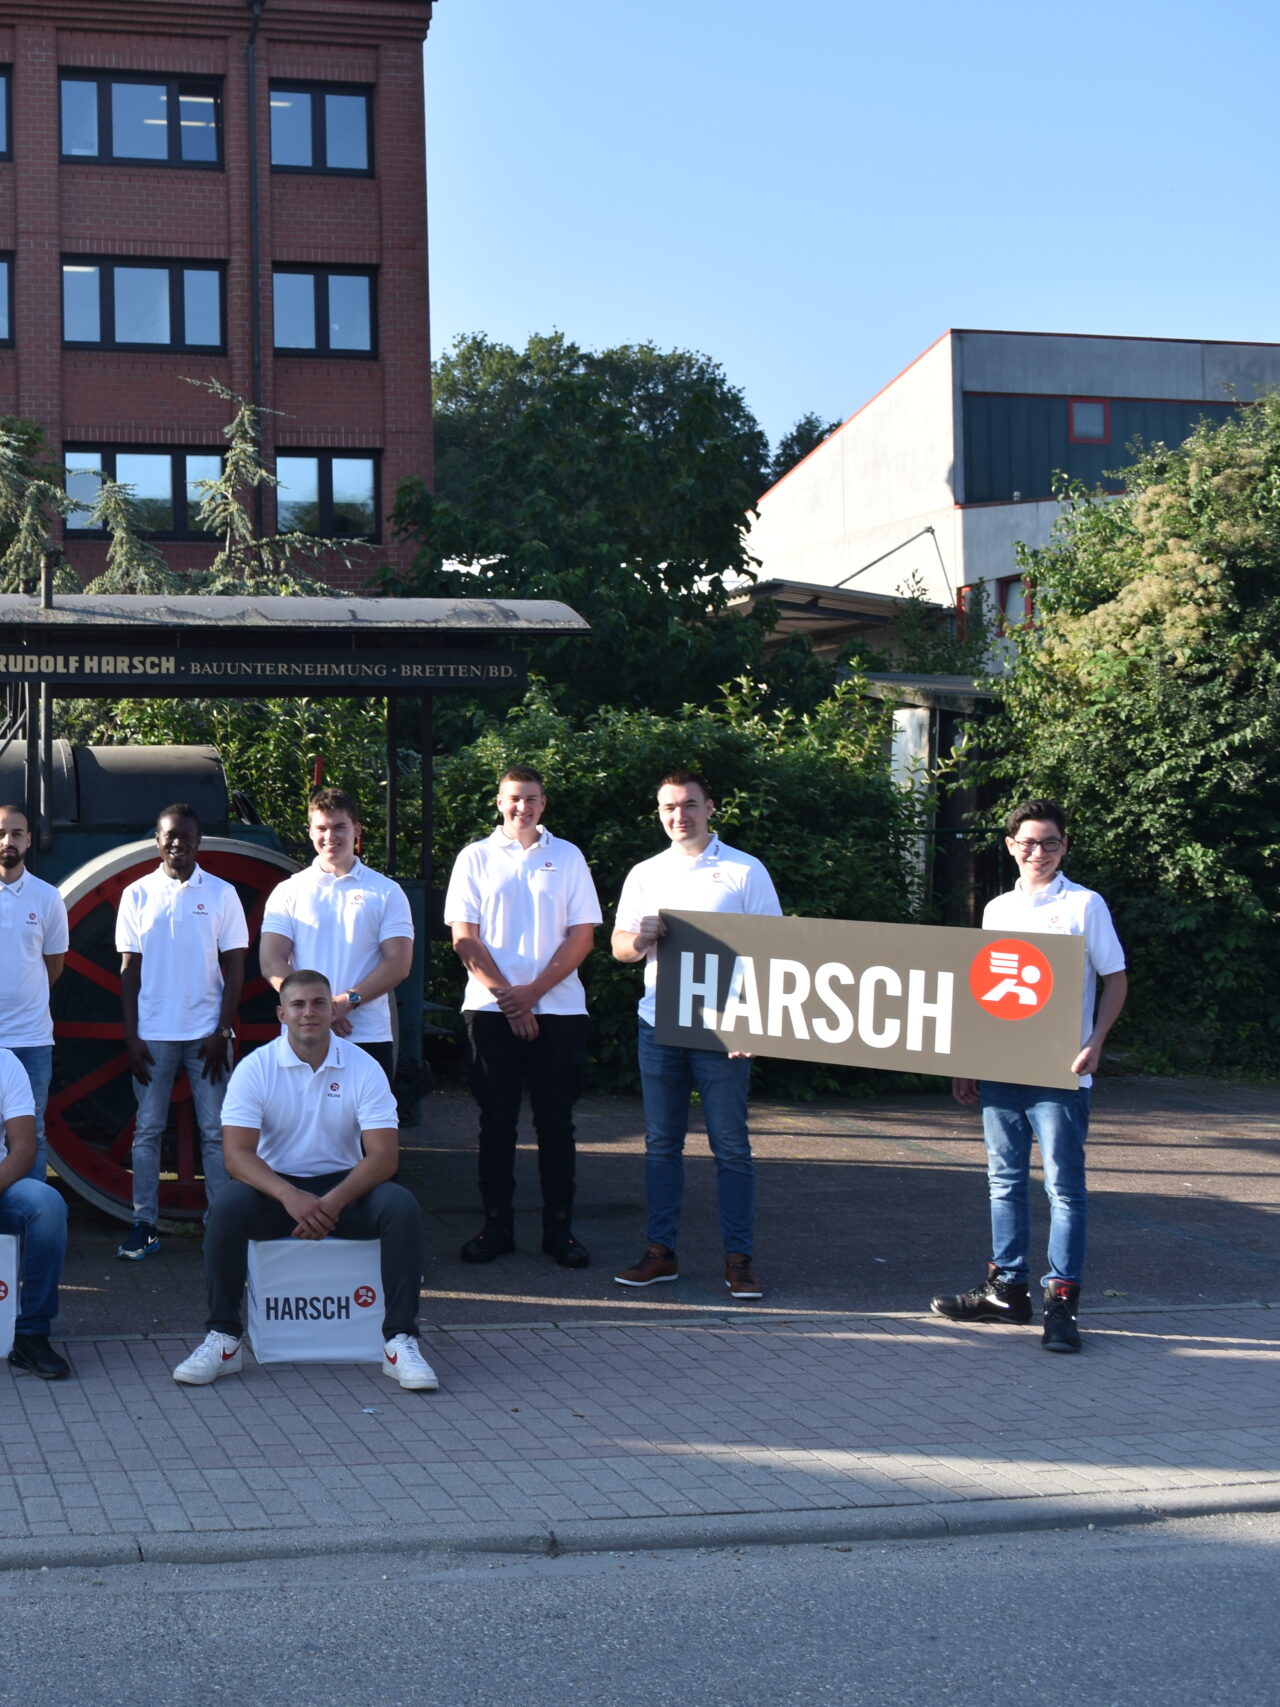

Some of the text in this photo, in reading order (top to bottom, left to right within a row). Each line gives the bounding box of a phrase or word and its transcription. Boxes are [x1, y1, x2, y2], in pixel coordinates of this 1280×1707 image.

[84, 655, 175, 675] HARSCH
[190, 662, 388, 677] BAUUNTERNEHMUNG
[678, 951, 954, 1055] HARSCH
[265, 1296, 350, 1321] HARSCH
